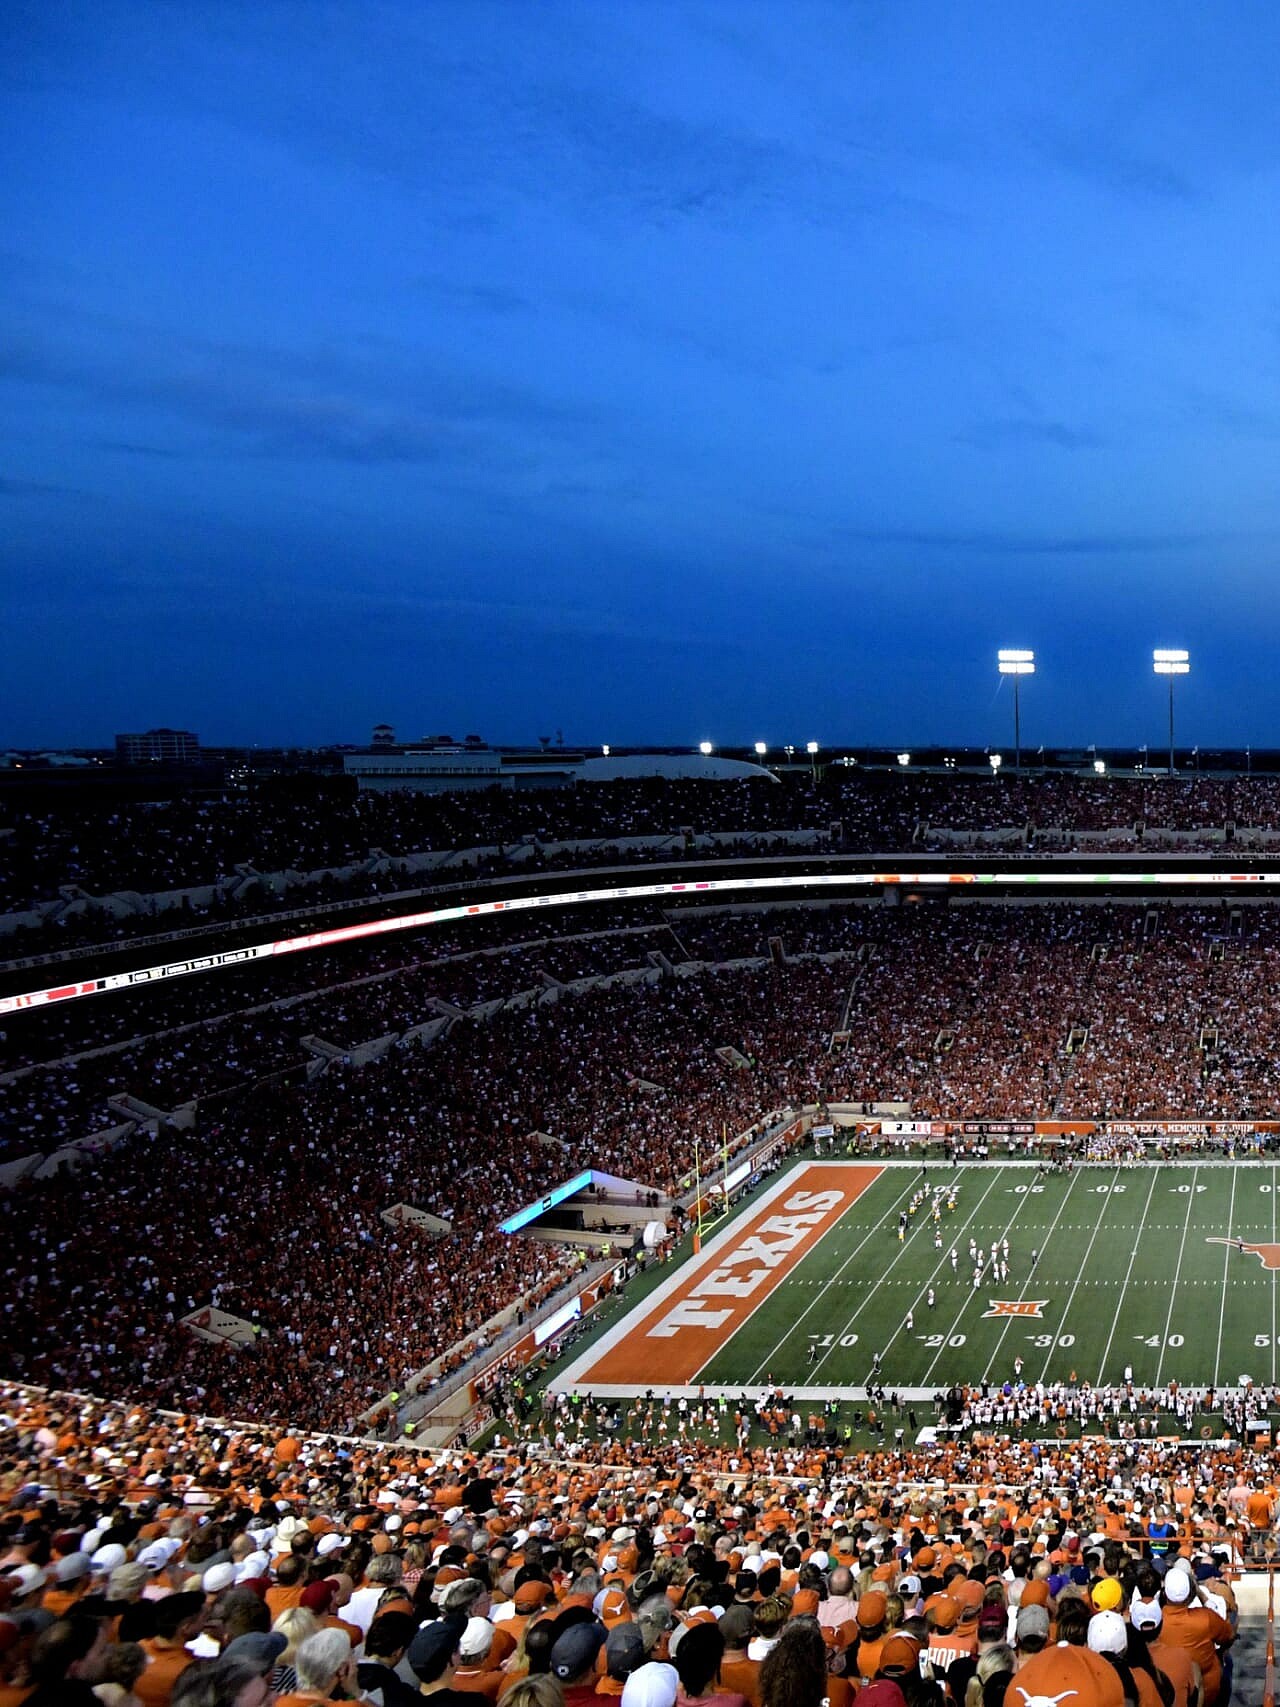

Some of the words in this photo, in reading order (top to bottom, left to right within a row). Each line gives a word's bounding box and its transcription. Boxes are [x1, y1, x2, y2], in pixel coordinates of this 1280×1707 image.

[1167, 1123, 1211, 1133] MEMORIA
[1215, 1123, 1254, 1133] STDIUM
[1014, 1184, 1045, 1194] 20
[1096, 1184, 1126, 1194] 30
[1177, 1184, 1207, 1194] 40
[647, 1190, 845, 1338] TEXAS
[817, 1333, 859, 1347] 10
[925, 1333, 967, 1347] 20
[1034, 1333, 1076, 1347] 30
[1144, 1333, 1185, 1348] 40
